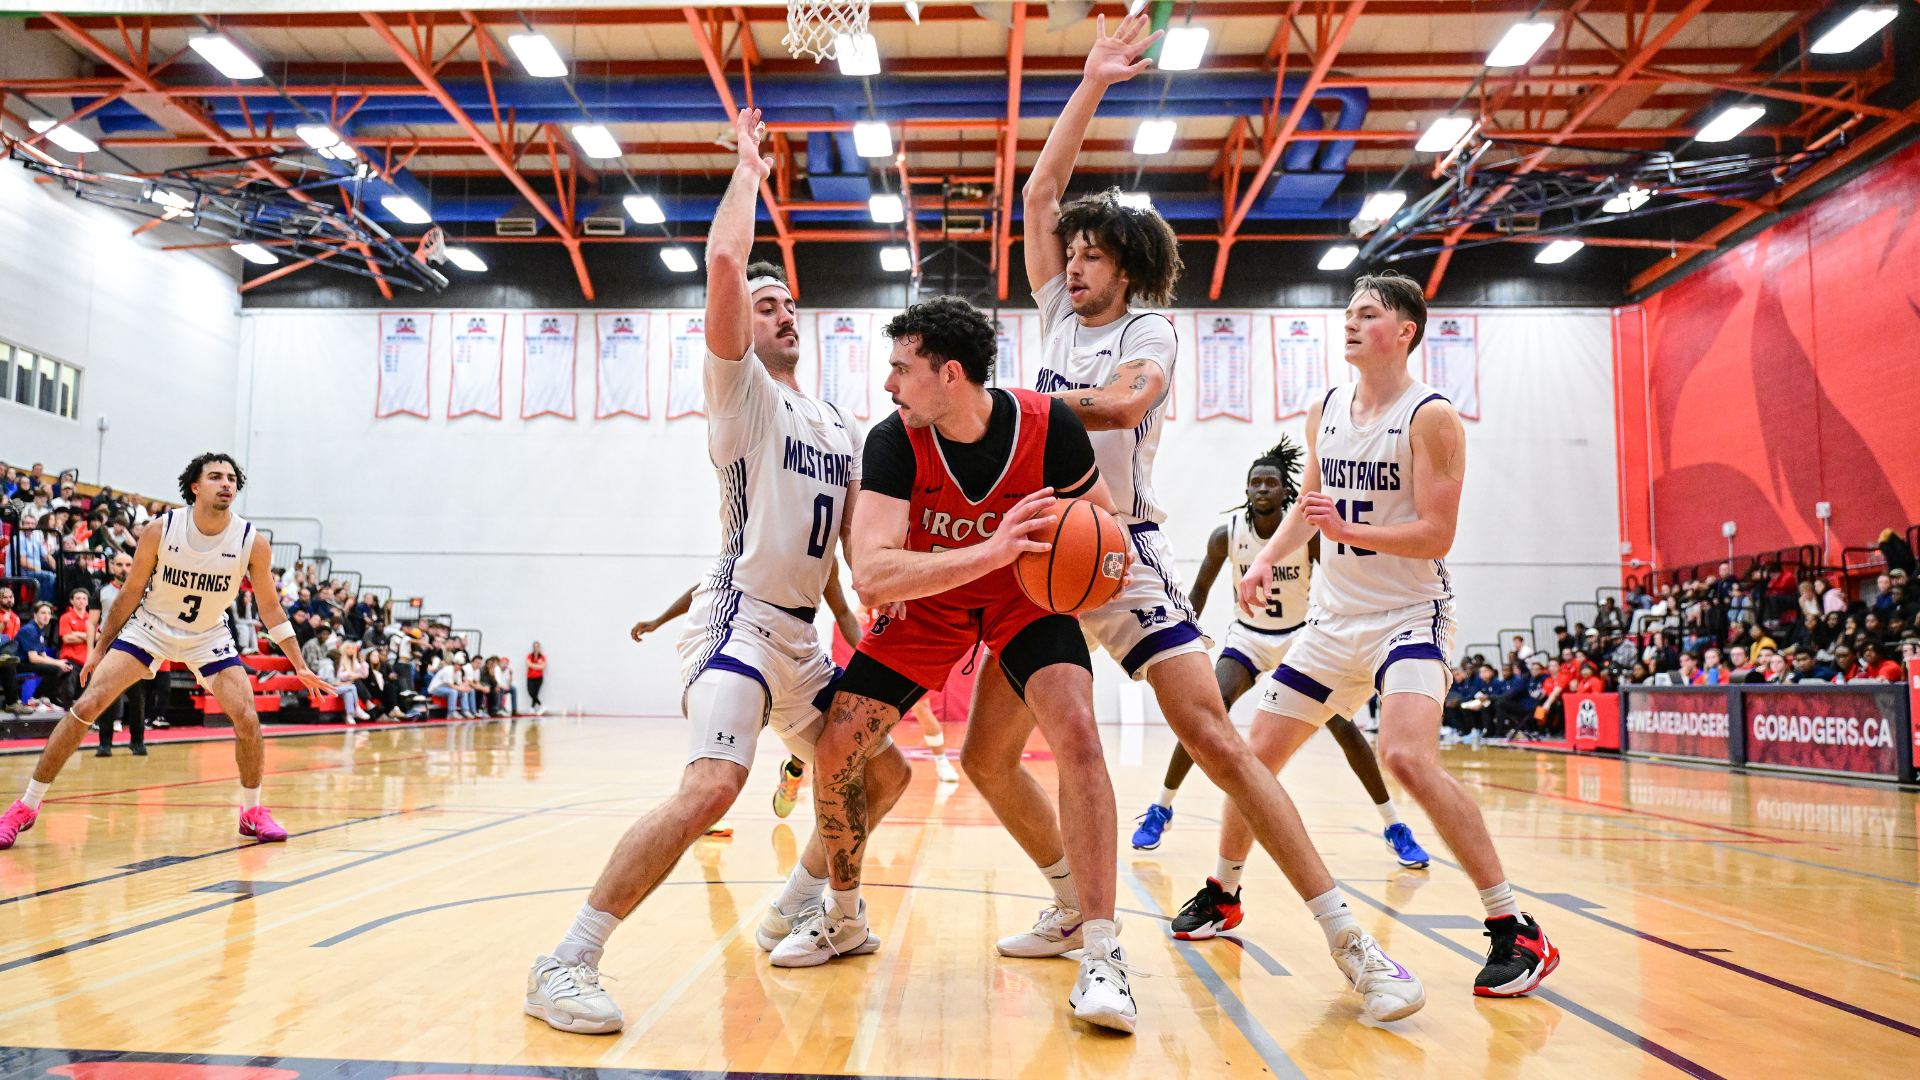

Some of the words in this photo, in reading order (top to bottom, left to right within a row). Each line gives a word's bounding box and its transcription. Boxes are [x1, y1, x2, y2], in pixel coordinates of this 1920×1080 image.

[782, 435, 854, 489] MUSTANG
[1321, 457, 1401, 491] MUSTANGS
[806, 492, 834, 560] 0
[921, 507, 1006, 542] ROC
[162, 564, 232, 592] MUSTANGS
[1239, 563, 1301, 582] MANGS
[177, 594, 203, 624] 3
[1265, 587, 1283, 618] 5
[870, 614, 891, 636] B
[1626, 710, 1730, 738] #WEAREBADGERS
[1753, 714, 1894, 748] GOBADGERS.CA
